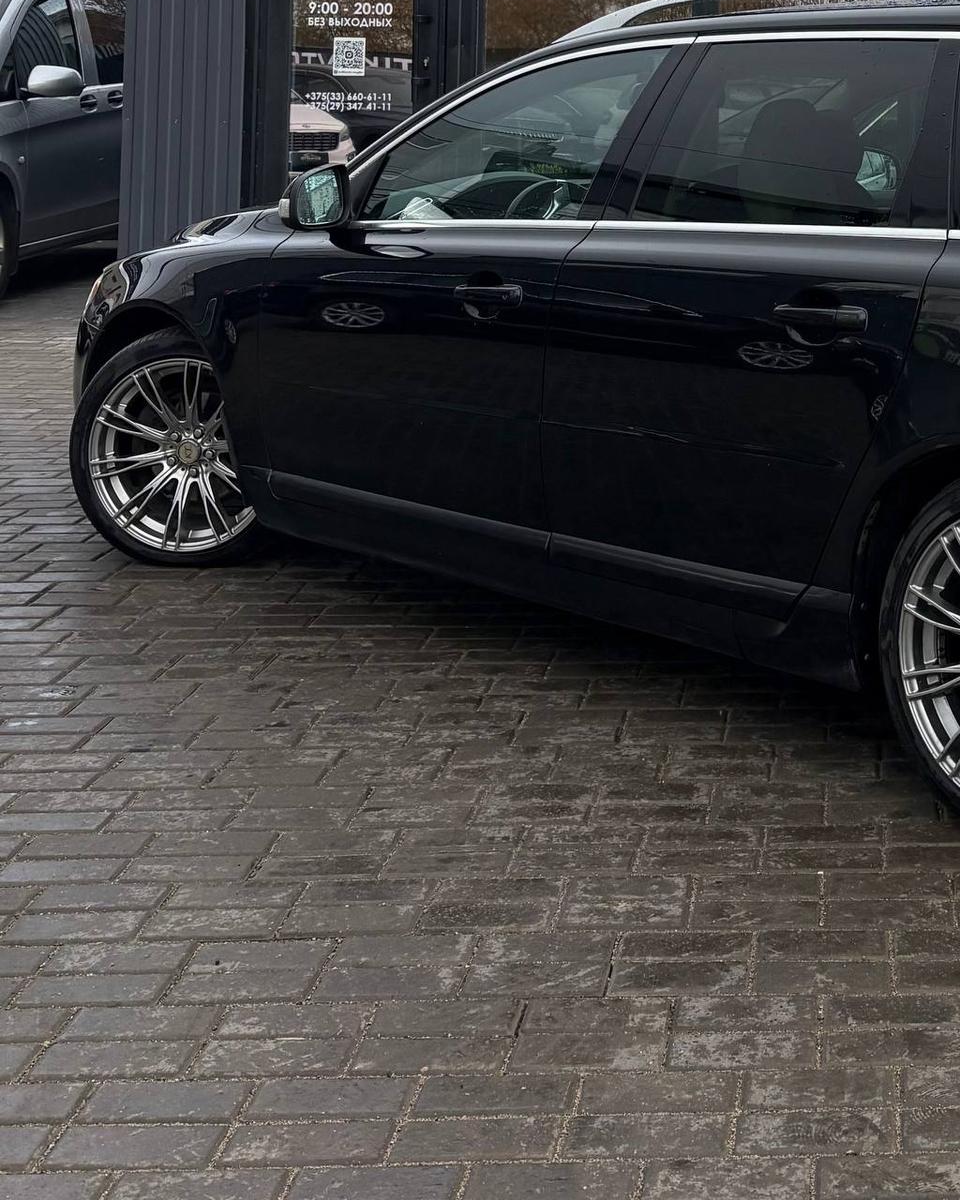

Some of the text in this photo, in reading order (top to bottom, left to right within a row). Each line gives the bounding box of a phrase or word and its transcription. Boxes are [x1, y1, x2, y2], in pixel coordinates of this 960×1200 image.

[308, 1, 339, 15] 9:00
[353, 2, 394, 15] 20:00
[307, 17, 393, 28] БЕЗ ВЫХОДНЫХ
[304, 91, 392, 102] +375(33) 660-61-11
